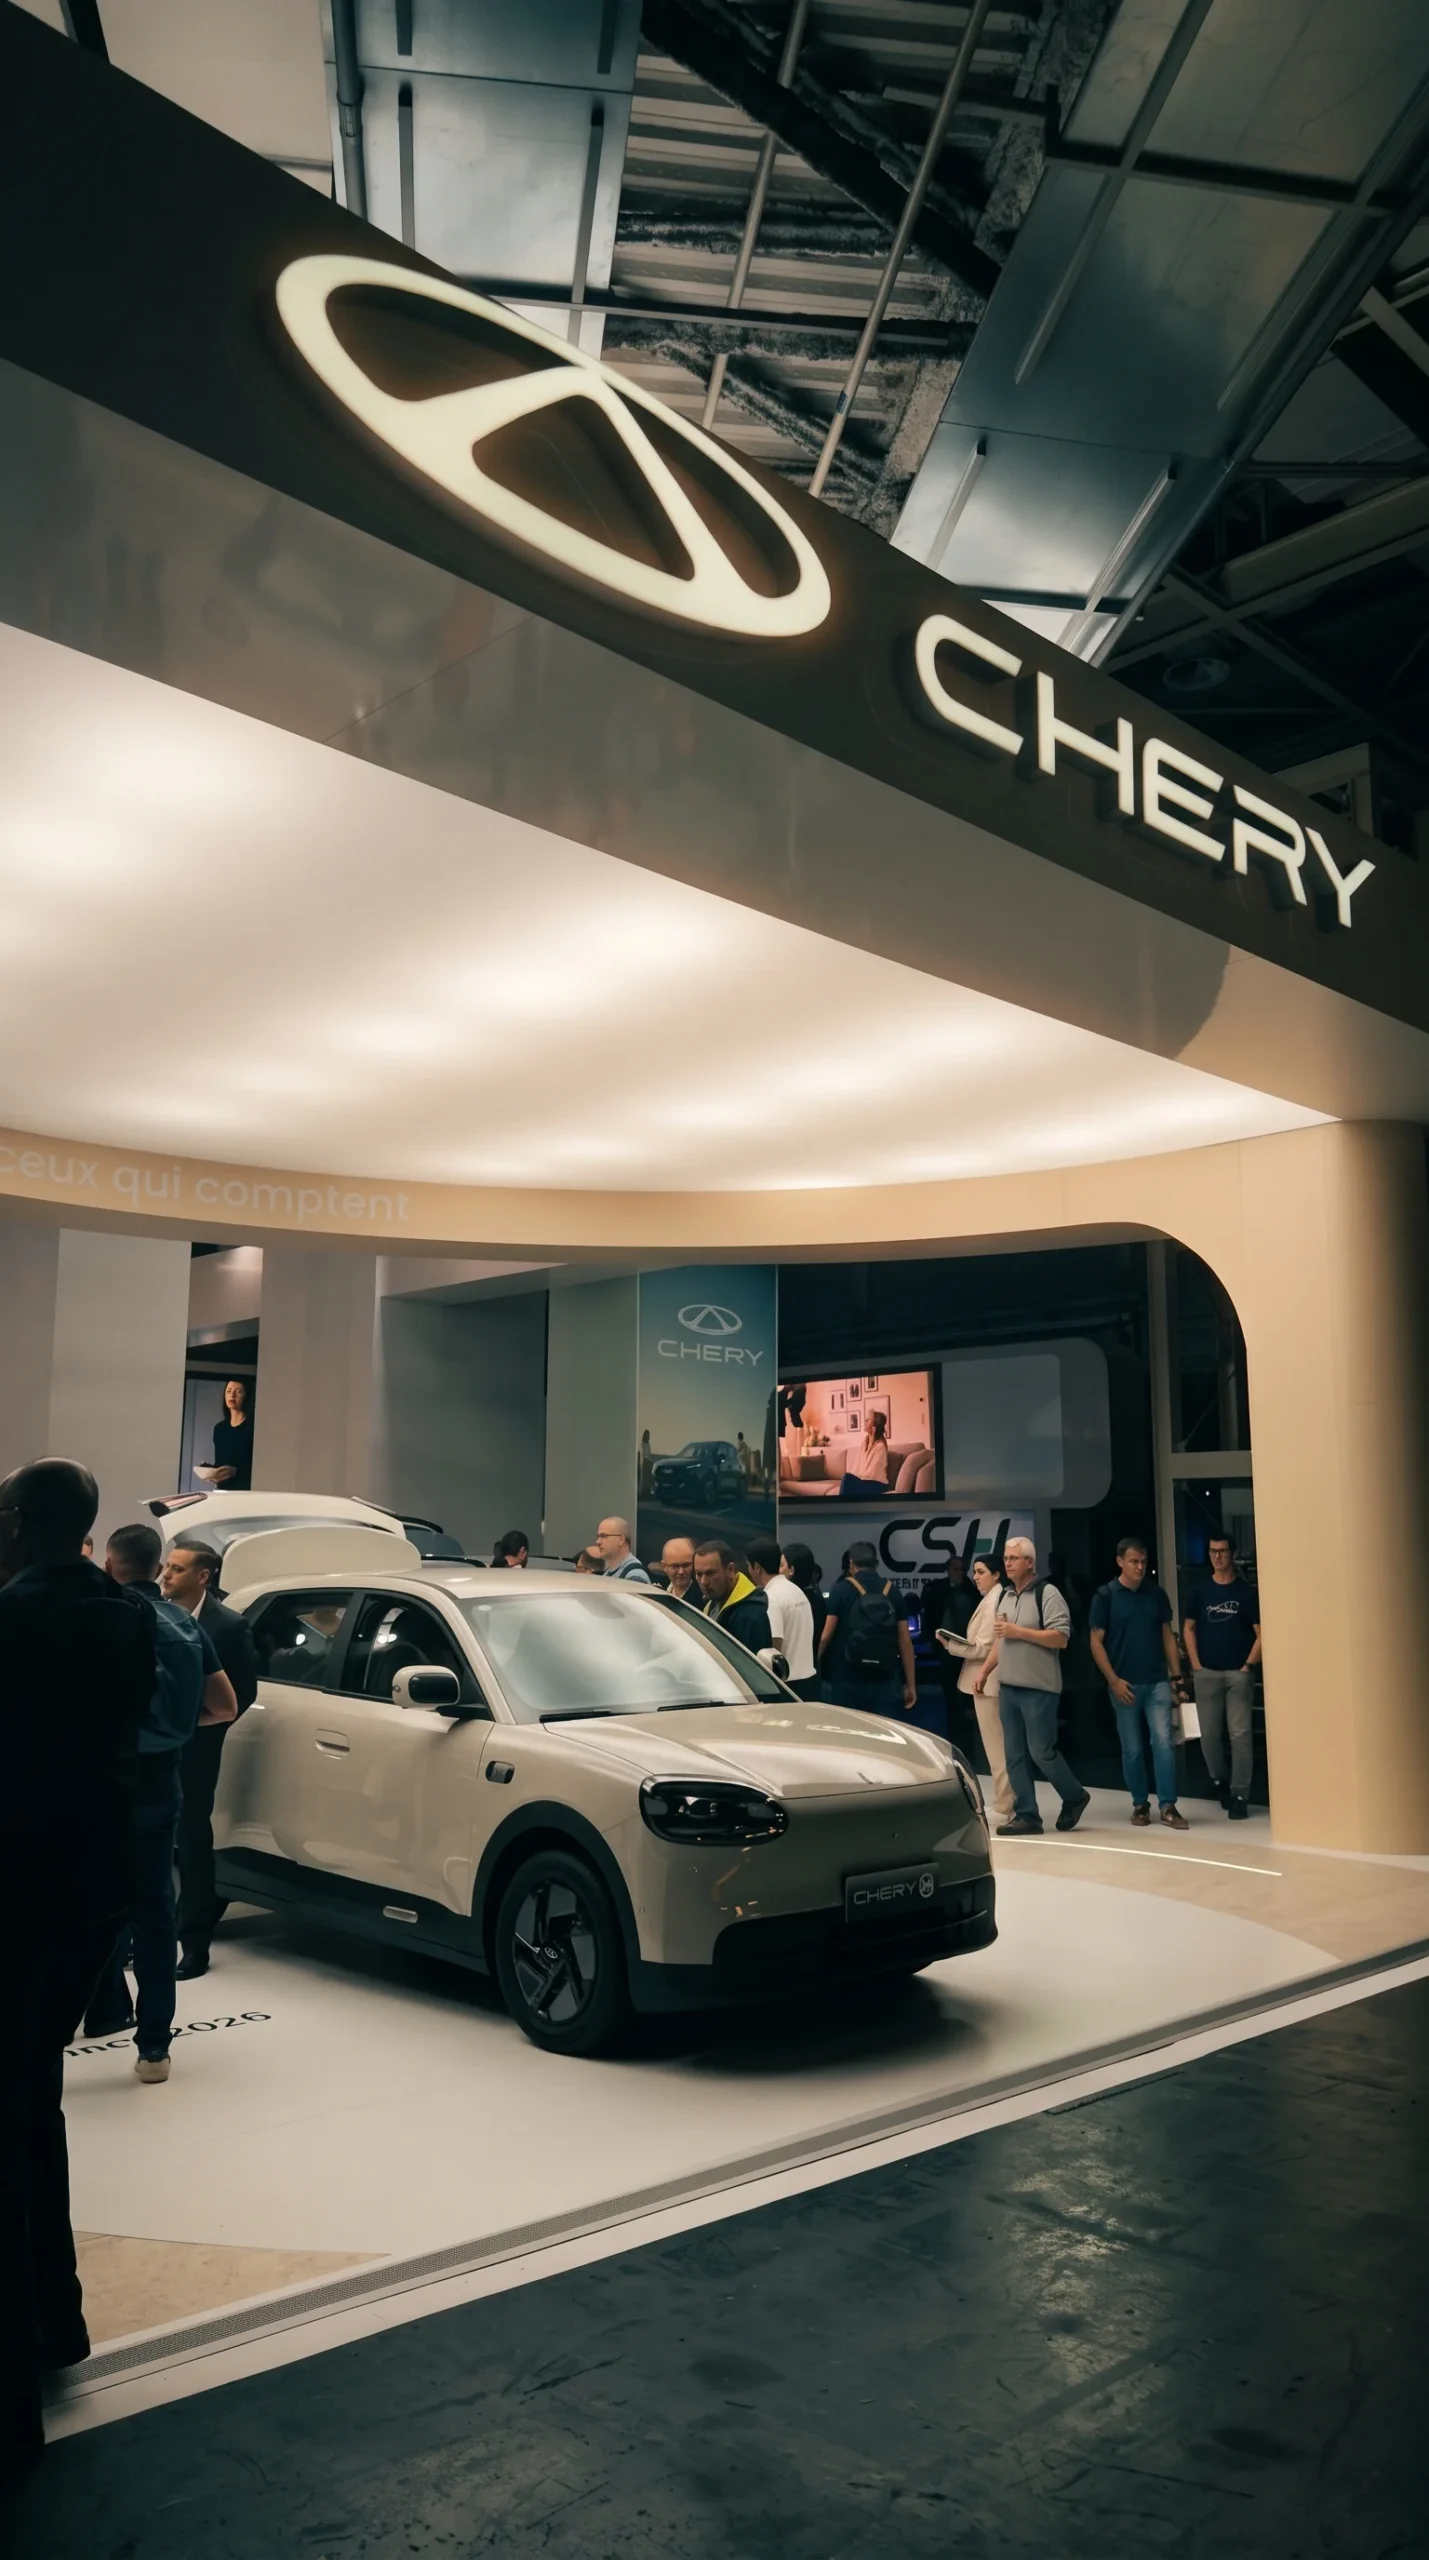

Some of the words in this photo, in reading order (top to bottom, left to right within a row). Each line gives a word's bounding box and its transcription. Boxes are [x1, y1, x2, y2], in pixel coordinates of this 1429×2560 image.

[914, 614, 1376, 928] CHERY
[113, 1164, 181, 1204] qui
[195, 1176, 410, 1221] comptent
[657, 1339, 764, 1366] CHERY
[879, 1516, 1011, 1574] CSH
[854, 1883, 917, 1905] CHERY
[169, 2011, 272, 2038] 2026
